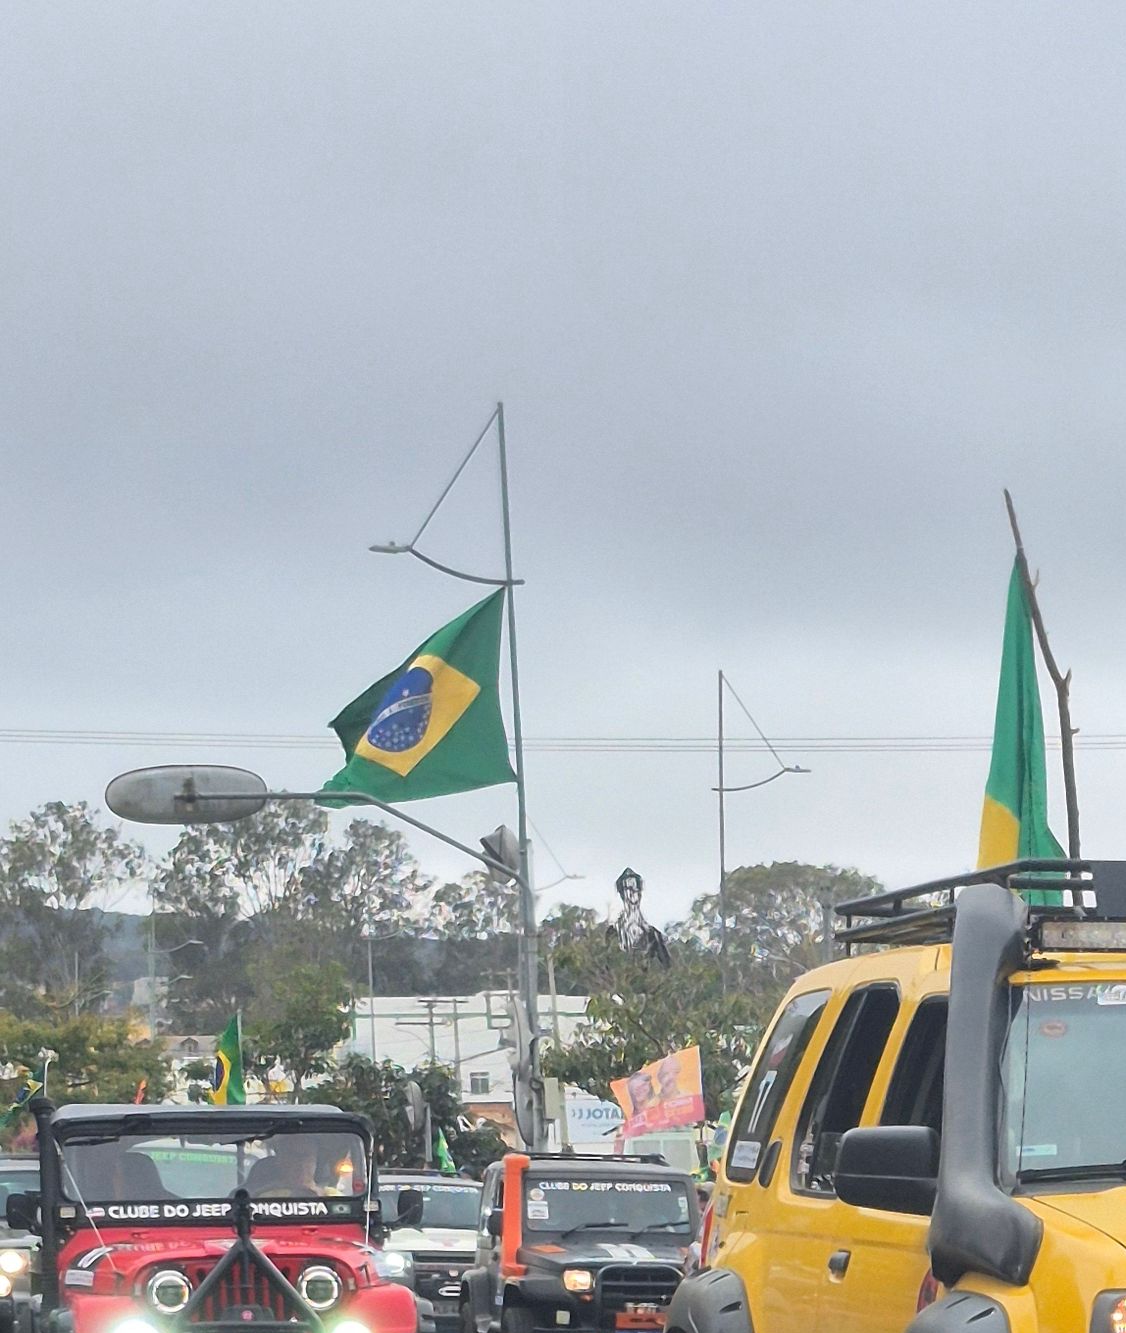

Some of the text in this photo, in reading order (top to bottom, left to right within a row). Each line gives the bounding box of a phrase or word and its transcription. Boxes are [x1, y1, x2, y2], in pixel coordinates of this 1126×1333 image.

[1025, 986, 1098, 1001] NISSA
[572, 1183, 588, 1191] DO
[108, 1203, 160, 1219] CLUBE
[164, 1204, 189, 1218] DO
[192, 1203, 232, 1217] JEEP
